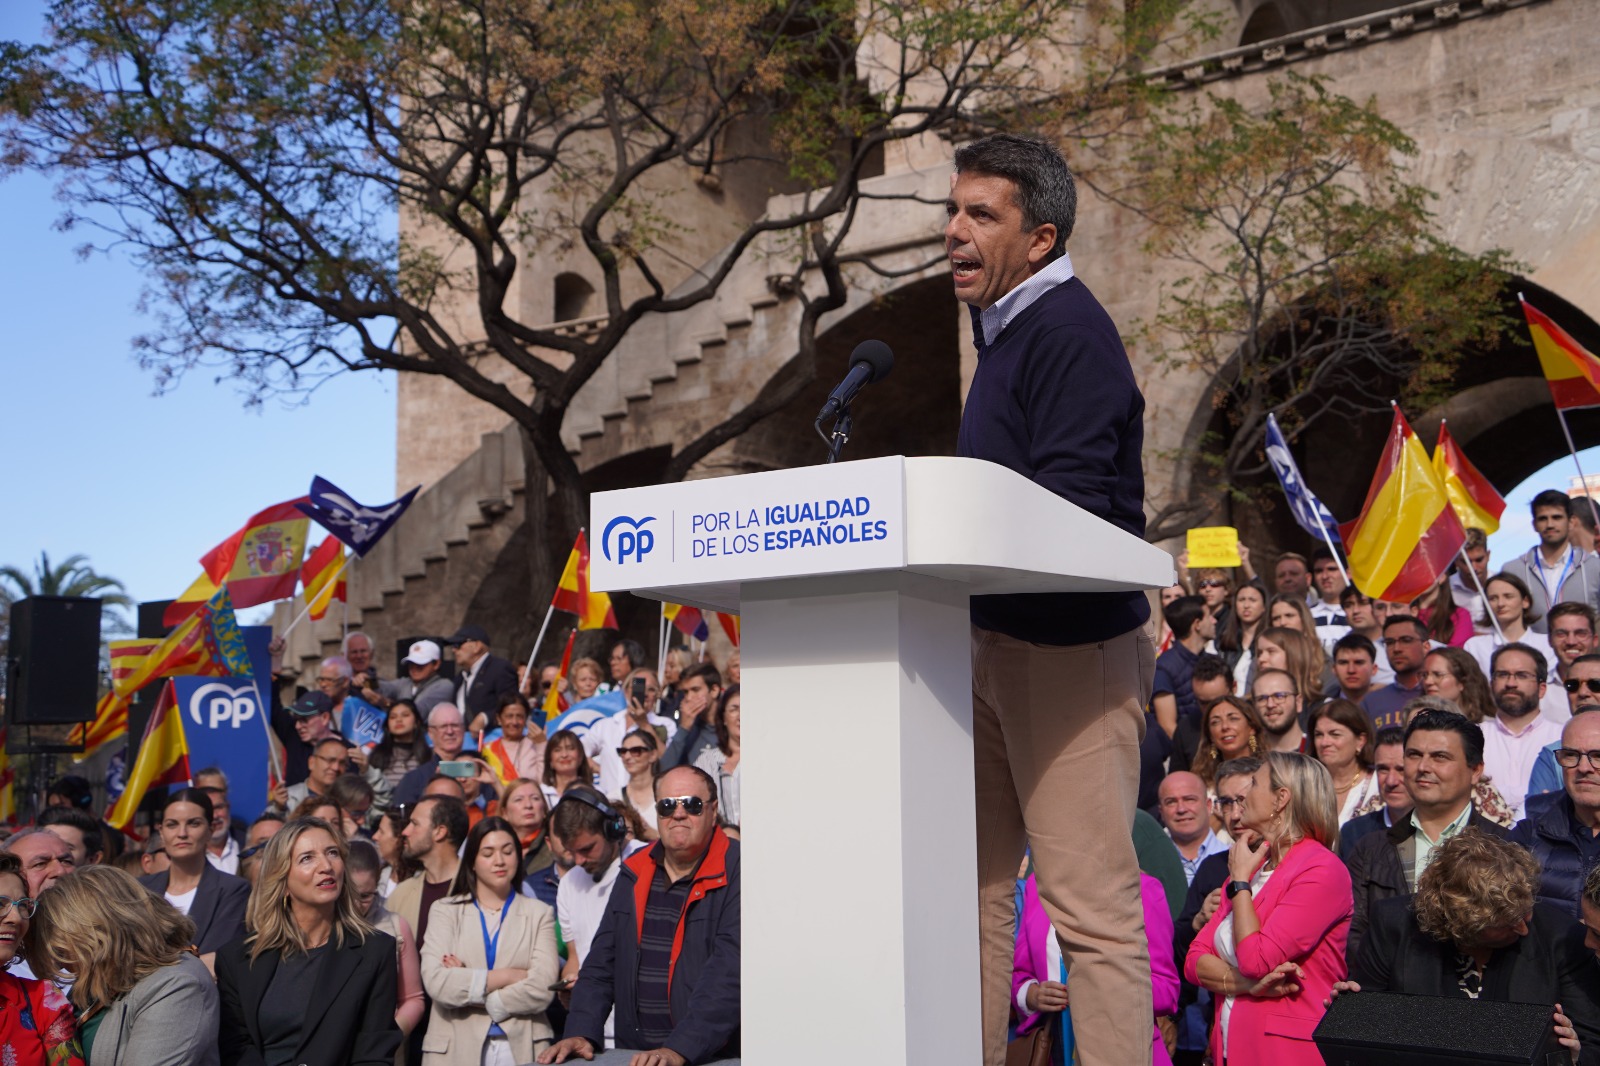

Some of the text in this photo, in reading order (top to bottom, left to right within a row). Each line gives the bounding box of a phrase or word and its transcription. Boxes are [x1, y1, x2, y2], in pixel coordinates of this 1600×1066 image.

[692, 496, 870, 533] POR LA IGUALDAD
[693, 519, 888, 558] DE LOS ESPAÑOLES
[353, 706, 384, 742] VA
[1375, 711, 1402, 729] SIL
